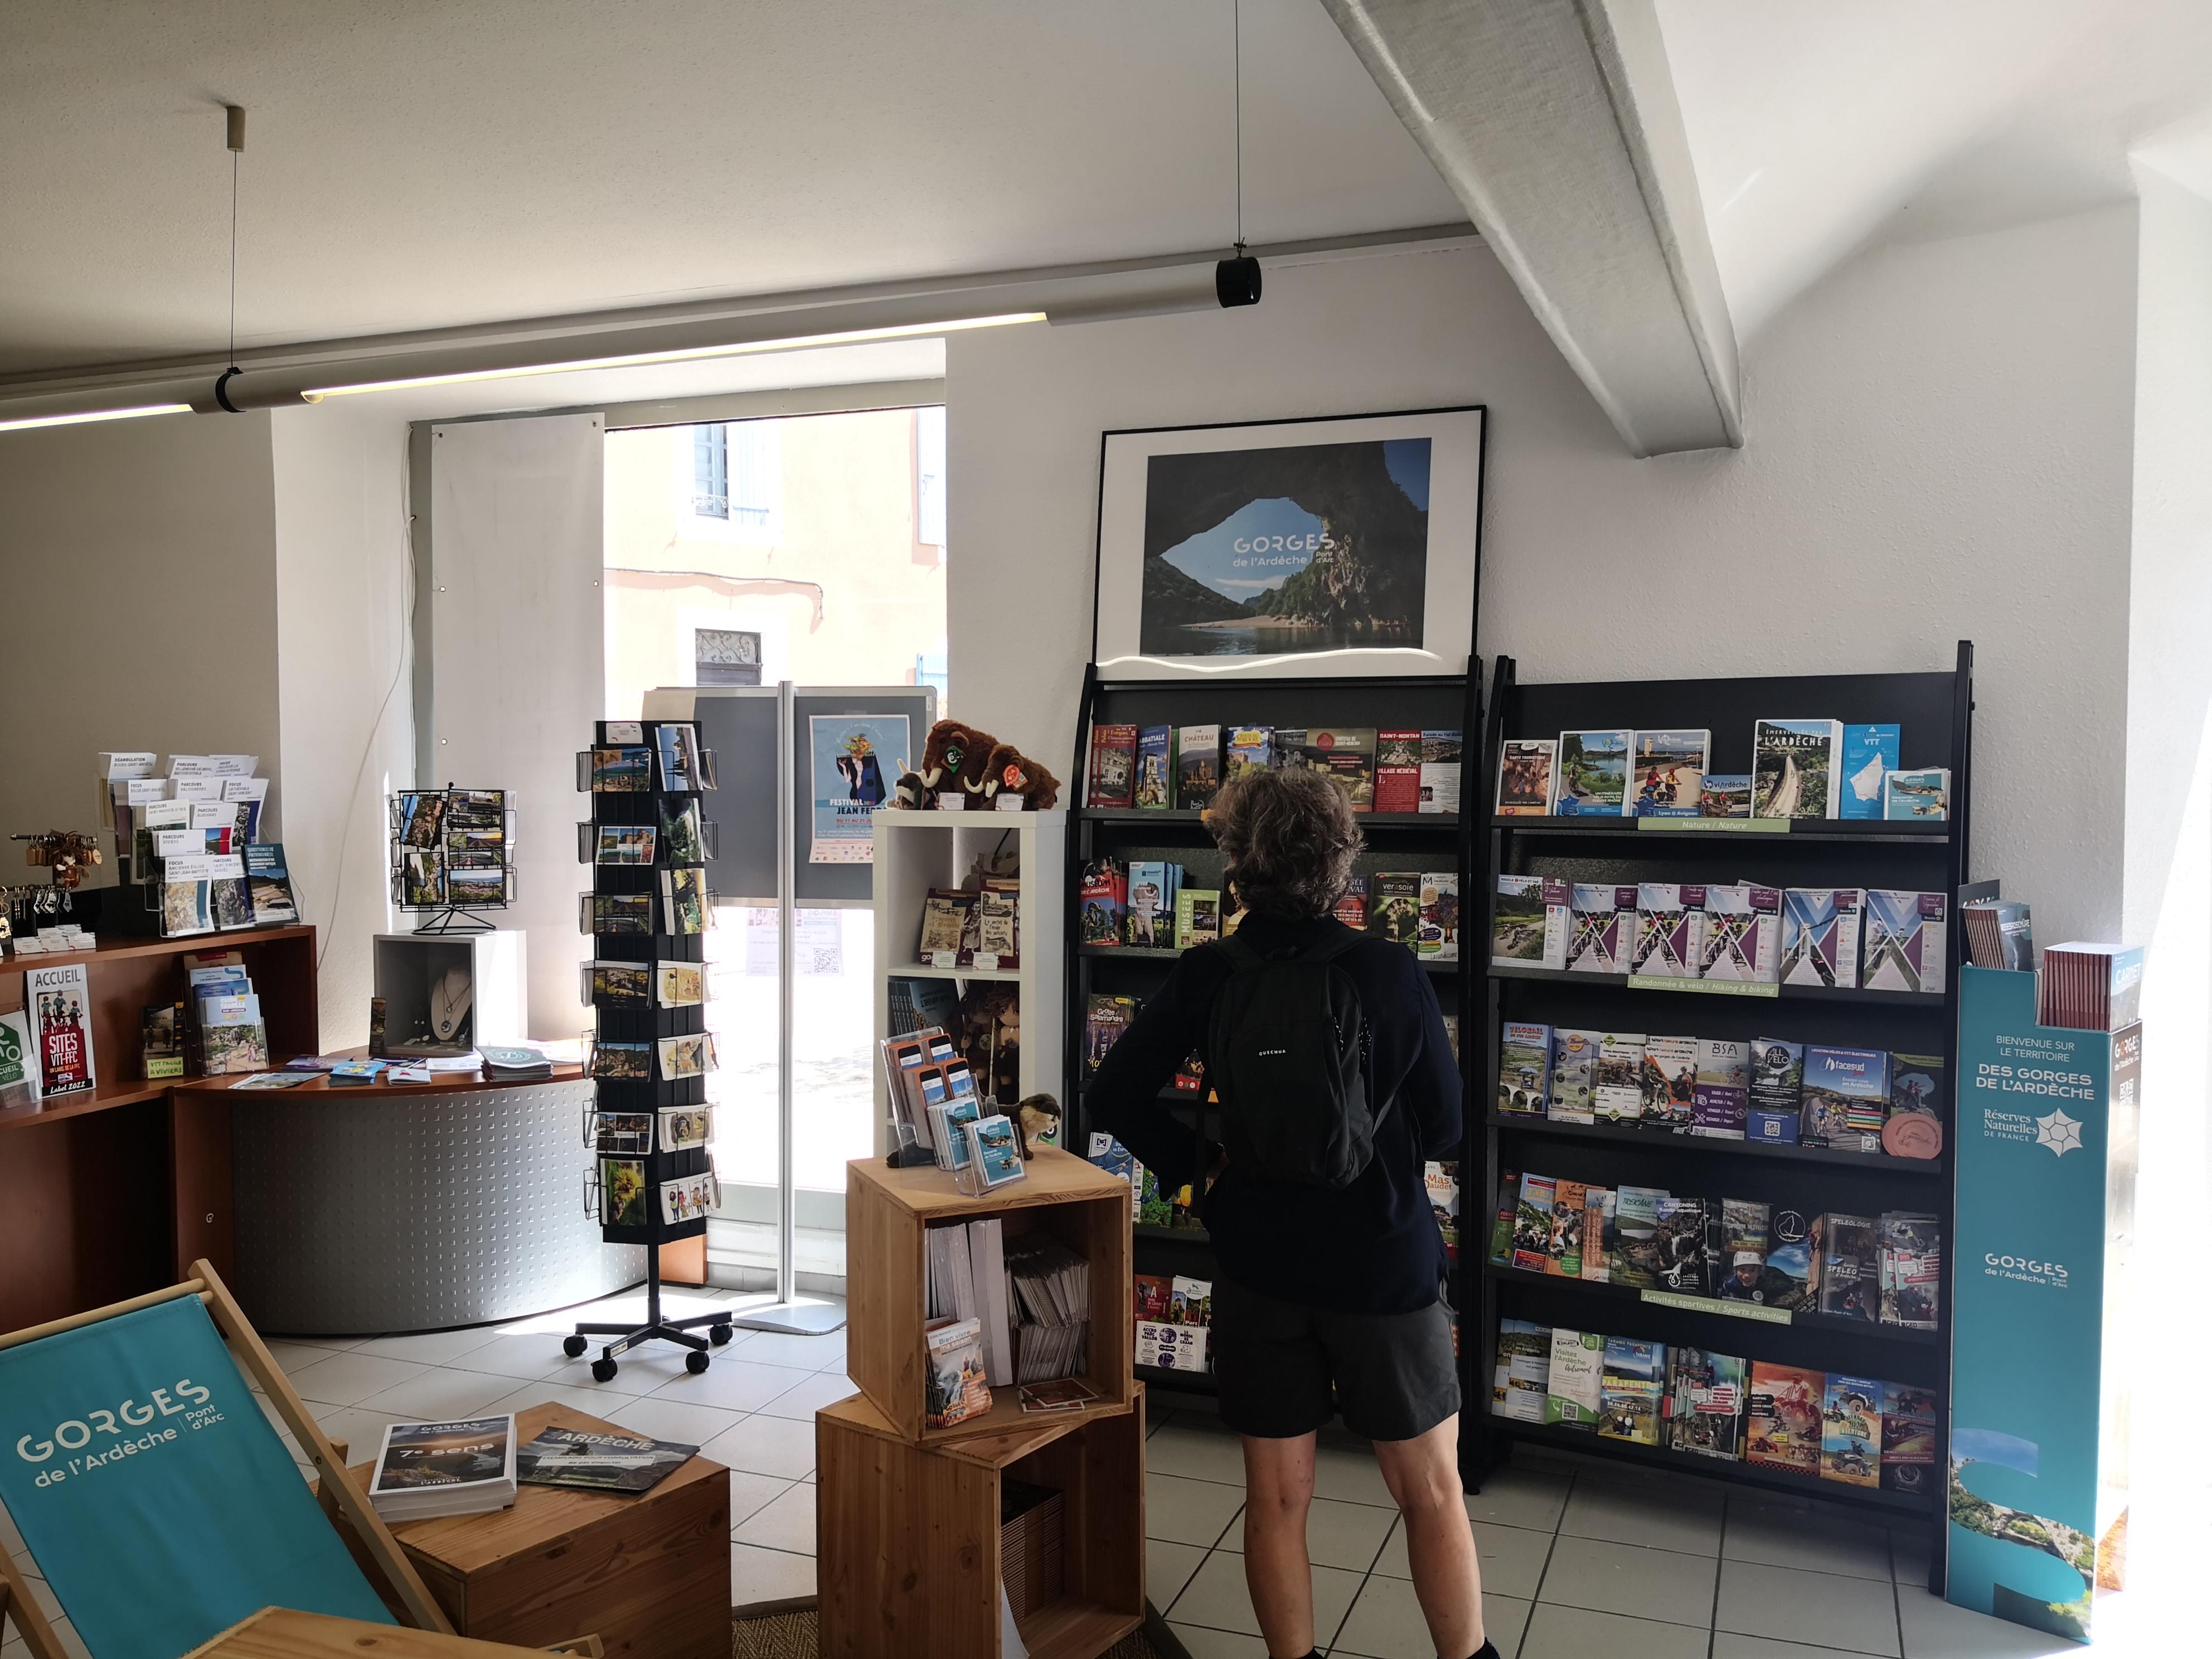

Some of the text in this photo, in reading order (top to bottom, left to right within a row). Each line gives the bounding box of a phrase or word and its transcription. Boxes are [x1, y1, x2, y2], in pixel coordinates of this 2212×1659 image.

[1233, 532, 1336, 554] GORGES
[1233, 555, 1307, 567] de l'Ardèche
[1185, 734, 1214, 743] CHÂTEAU
[1765, 735, 1823, 746] L'ARDÈCHE
[1181, 893, 1192, 933] MUSÉES
[35, 969, 81, 987] ACCUEIL
[2115, 963, 2141, 984] CARNET
[1633, 978, 1677, 988] Randonnée
[1687, 980, 1704, 989] vélo
[1711, 982, 1738, 993] Hiking
[1748, 986, 1774, 996] biking
[49, 1032, 78, 1054] SITES
[1712, 1043, 1738, 1056] BSA
[1996, 1035, 2075, 1051] BIENVENUE SUR
[2114, 1034, 2140, 1059] GORGES
[51, 1050, 78, 1067] VTT-FFC
[1768, 1048, 1783, 1056] ALL
[2000, 1047, 2070, 1063] LE TERRITOIRE
[1836, 1060, 1865, 1071] facesud
[2, 1072, 17, 1080] VÉLO
[1978, 1064, 2092, 1085] DES GORGES
[50, 1080, 85, 1094] Label 2022
[1976, 1077, 2095, 1100] DE L'ARDÈCHE
[1984, 1108, 2031, 1124] Réserves
[1984, 1119, 2038, 1135] Naturelles
[1997, 1133, 2030, 1142] FRANCE
[1428, 1174, 1449, 1185] Mas
[1831, 1218, 1871, 1229] SPELEOLOGIE
[1827, 1265, 1857, 1275] SPELEO
[1985, 1253, 2069, 1278] GORGES
[1985, 1268, 2046, 1284] de l'Ardèche
[1643, 1294, 1677, 1305] Activités
[1678, 1299, 1715, 1311] sportives
[1723, 1306, 1750, 1317] Sports
[1752, 1309, 1789, 1321] activities
[939, 1330, 971, 1345] Bien vivre
[940, 1343, 951, 1352] ma
[952, 1336, 972, 1348] saison
[1554, 1355, 1586, 1365] l'Ardèche
[1555, 1348, 1577, 1357] Visitez
[1564, 1364, 1592, 1374] Autrement
[17, 1379, 210, 1462] GORGES
[185, 1404, 216, 1422] Pont
[192, 1412, 225, 1430] d'Arc
[421, 1423, 481, 1432] GORGES
[431, 1443, 495, 1456] sens
[557, 1432, 656, 1451] ARDÈCHE
[35, 1426, 178, 1488] de l'Ardèche
